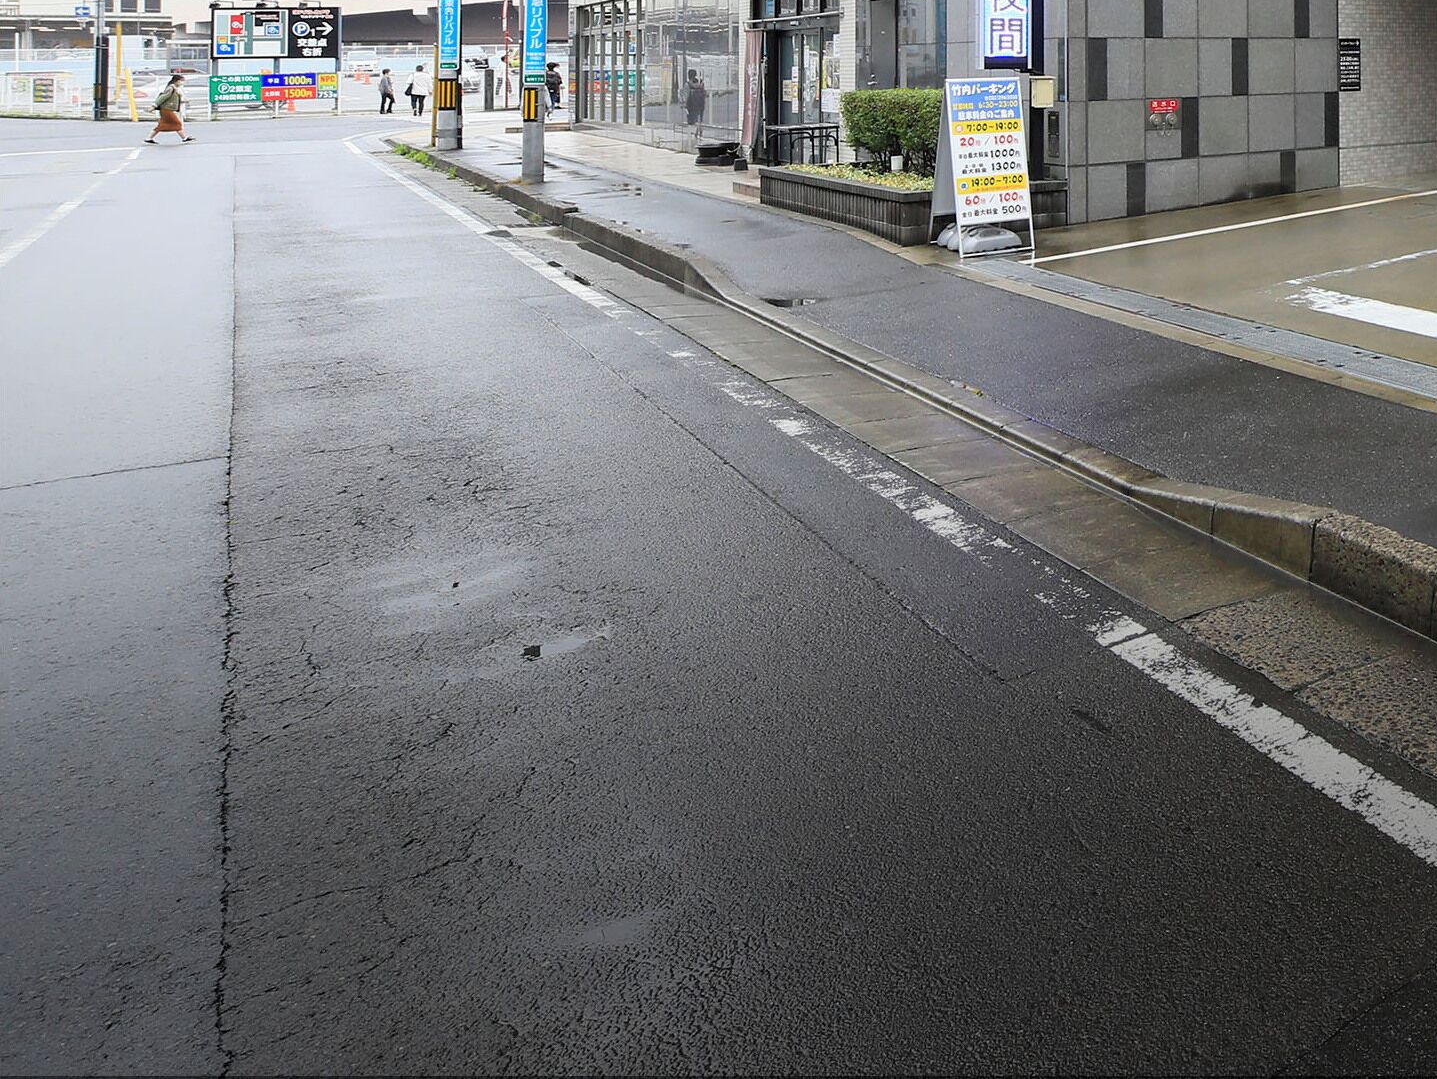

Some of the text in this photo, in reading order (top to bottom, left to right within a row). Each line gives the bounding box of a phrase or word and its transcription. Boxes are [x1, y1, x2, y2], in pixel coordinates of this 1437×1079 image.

[951, 82, 1017, 96] 竹内パーキング
